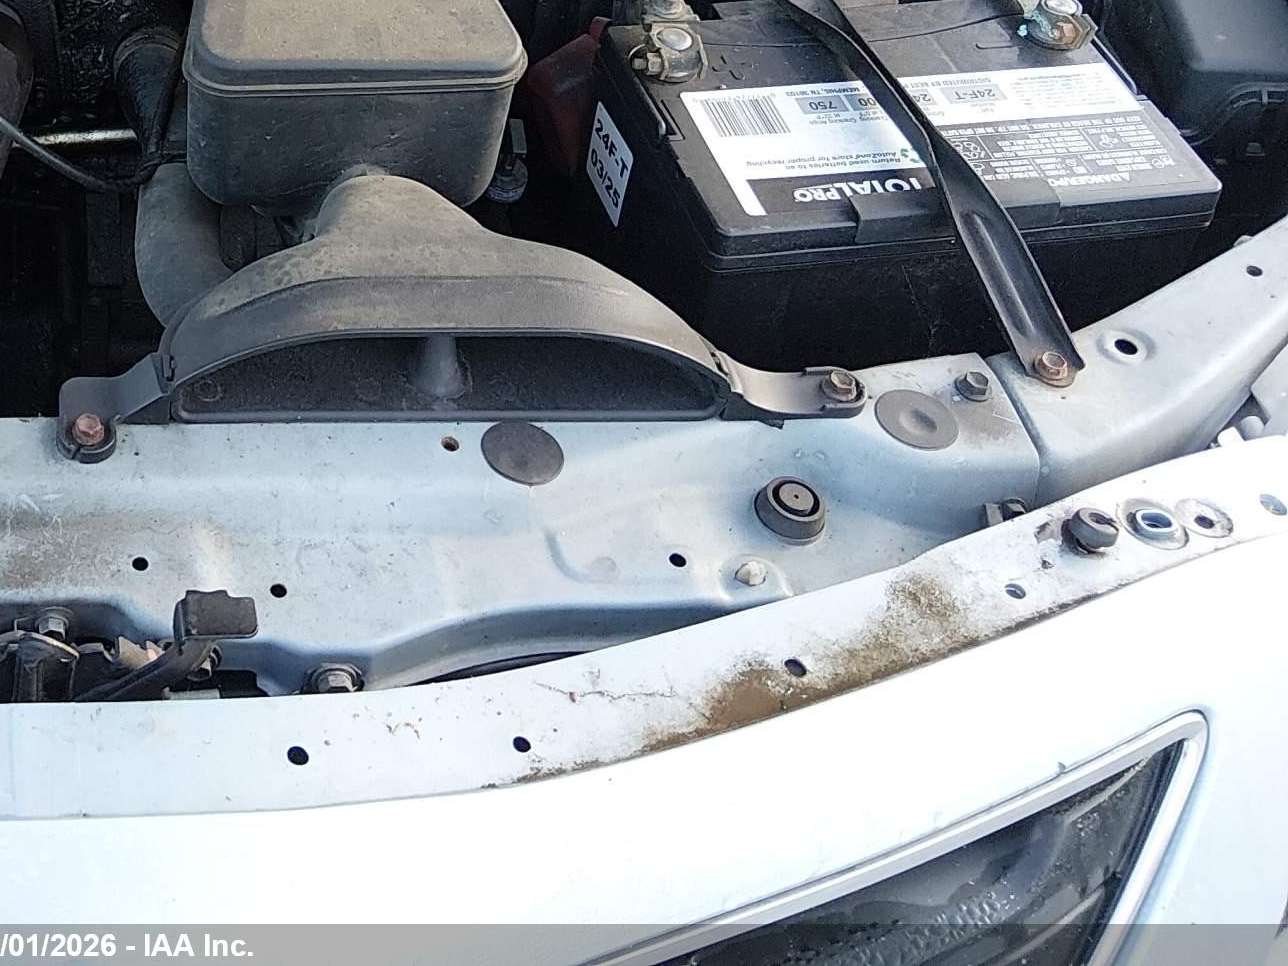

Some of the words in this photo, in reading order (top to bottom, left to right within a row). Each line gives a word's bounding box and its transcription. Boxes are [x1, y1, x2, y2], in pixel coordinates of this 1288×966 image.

[954, 89, 996, 100] 24F-T
[808, 101, 838, 111] 750
[594, 117, 629, 179] 24F-T
[788, 156, 815, 164] proper
[848, 159, 869, 167] used
[872, 157, 901, 165] Return
[808, 161, 847, 169] batteries
[590, 147, 621, 208] 03/25
